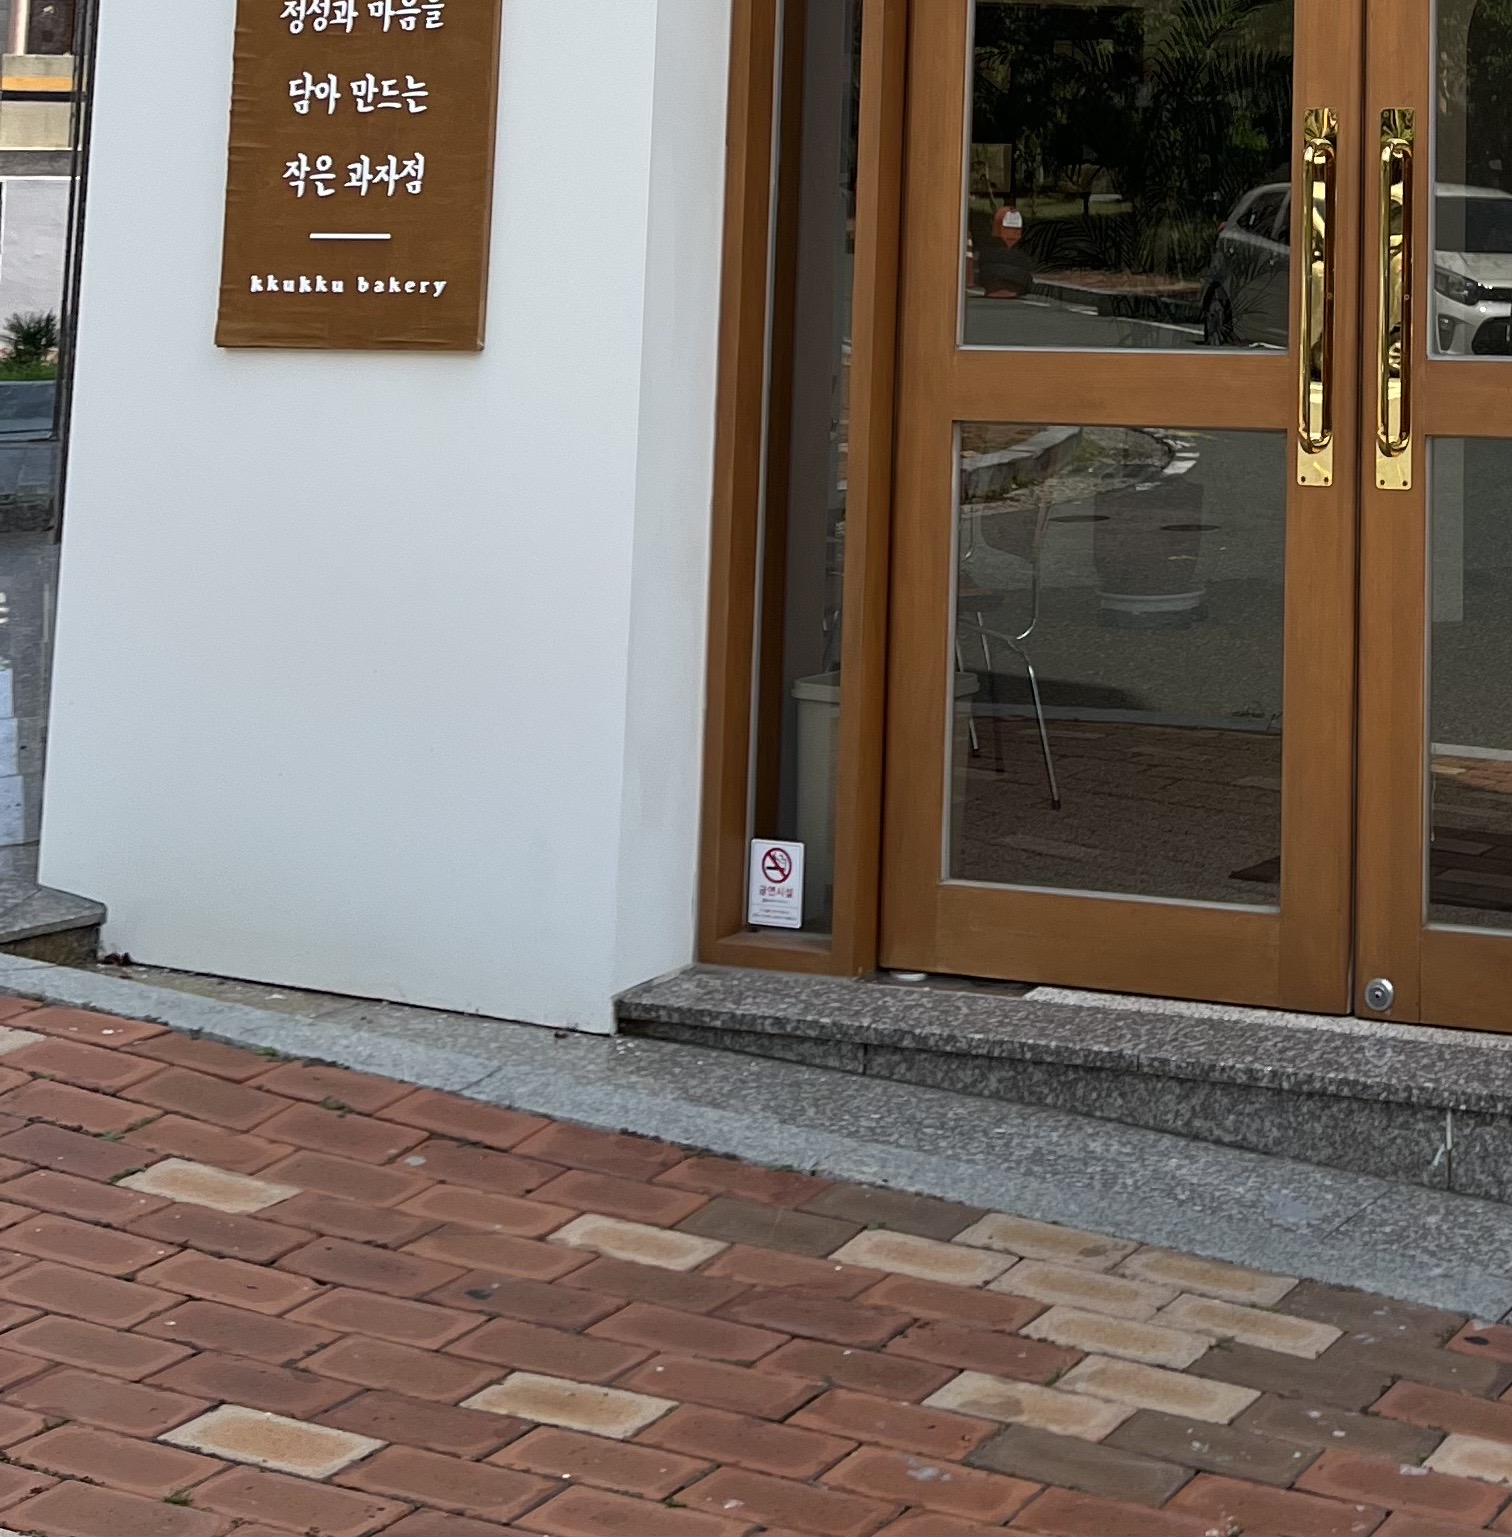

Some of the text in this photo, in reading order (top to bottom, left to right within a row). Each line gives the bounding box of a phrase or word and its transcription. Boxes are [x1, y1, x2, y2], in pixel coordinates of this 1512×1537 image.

[288, 71, 429, 115] 담아 만드는
[282, 152, 425, 198] 작은 과자점
[250, 274, 447, 298] kkukku bakery
